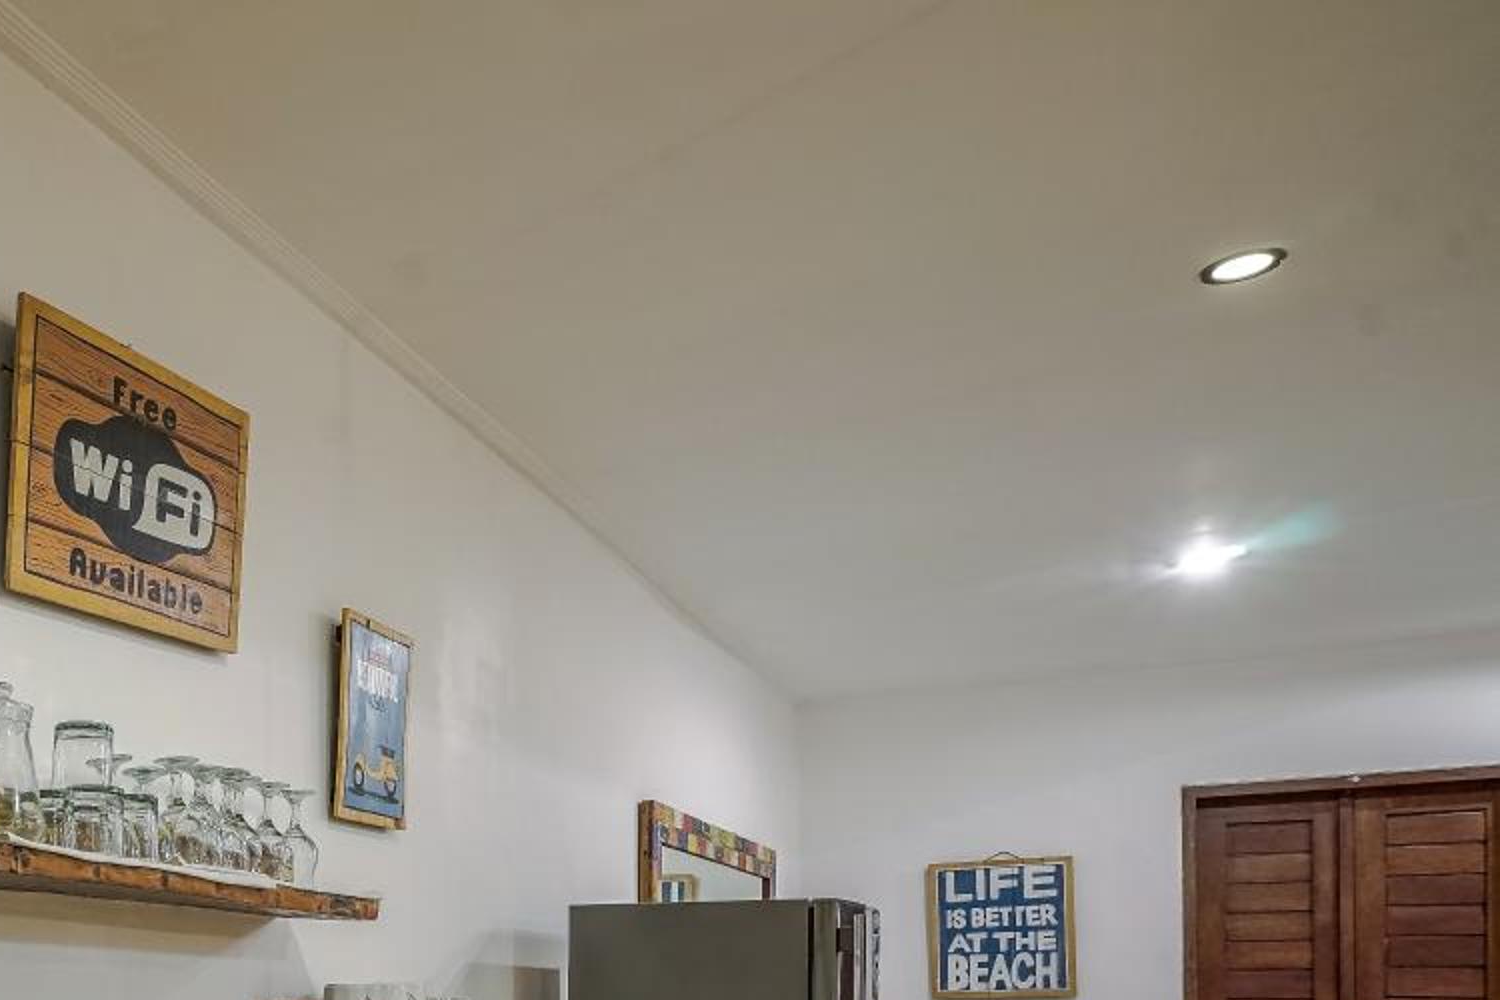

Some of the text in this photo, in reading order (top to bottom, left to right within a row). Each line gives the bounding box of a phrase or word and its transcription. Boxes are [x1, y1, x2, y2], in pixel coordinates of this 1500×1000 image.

[112, 375, 177, 431] Free
[68, 547, 204, 615] Available
[945, 864, 1058, 902] LIFE
[946, 904, 1058, 929] IS BETTER
[948, 929, 1057, 953] AT THE
[947, 951, 1059, 991] BEACH
